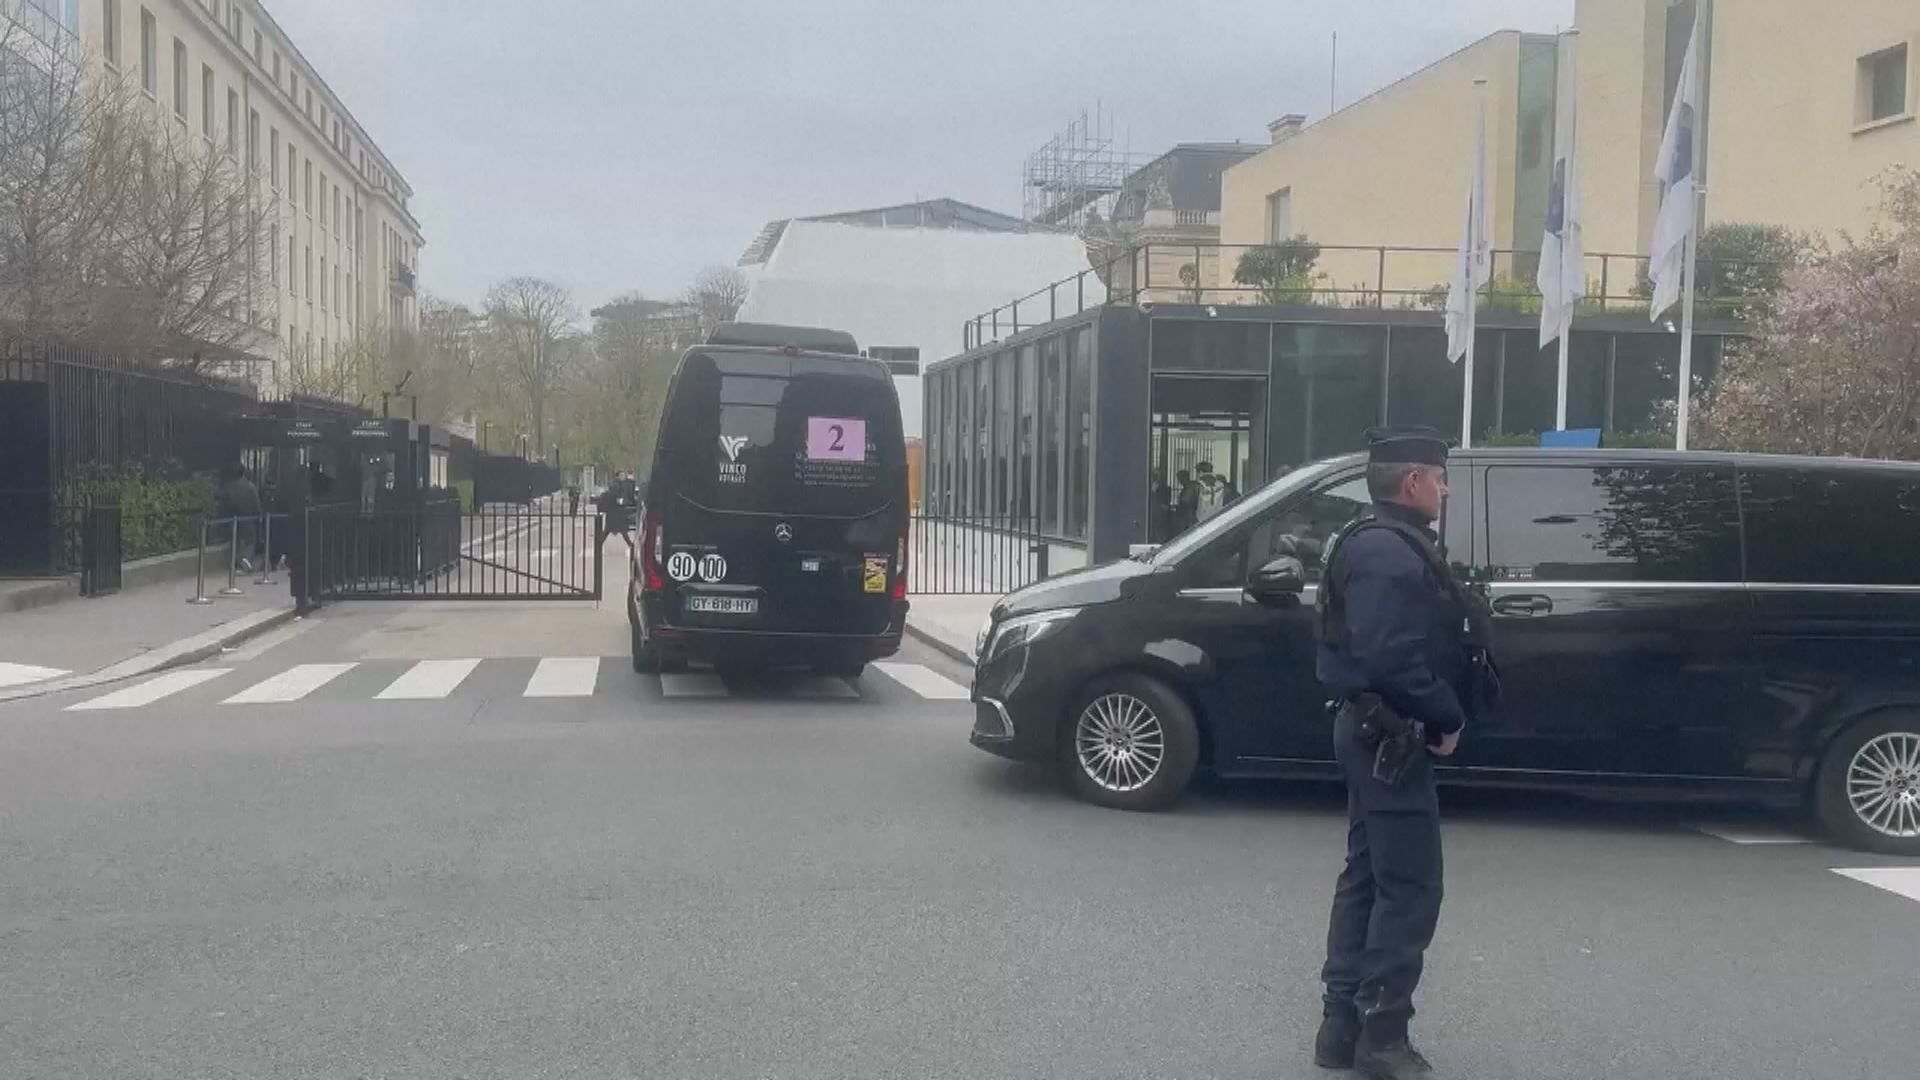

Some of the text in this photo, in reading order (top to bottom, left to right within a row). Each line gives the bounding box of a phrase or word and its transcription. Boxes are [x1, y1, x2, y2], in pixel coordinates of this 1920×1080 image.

[828, 424, 845, 452] 2
[719, 463, 747, 475] VINCO
[673, 556, 692, 577] 90
[704, 558, 724, 579] 100
